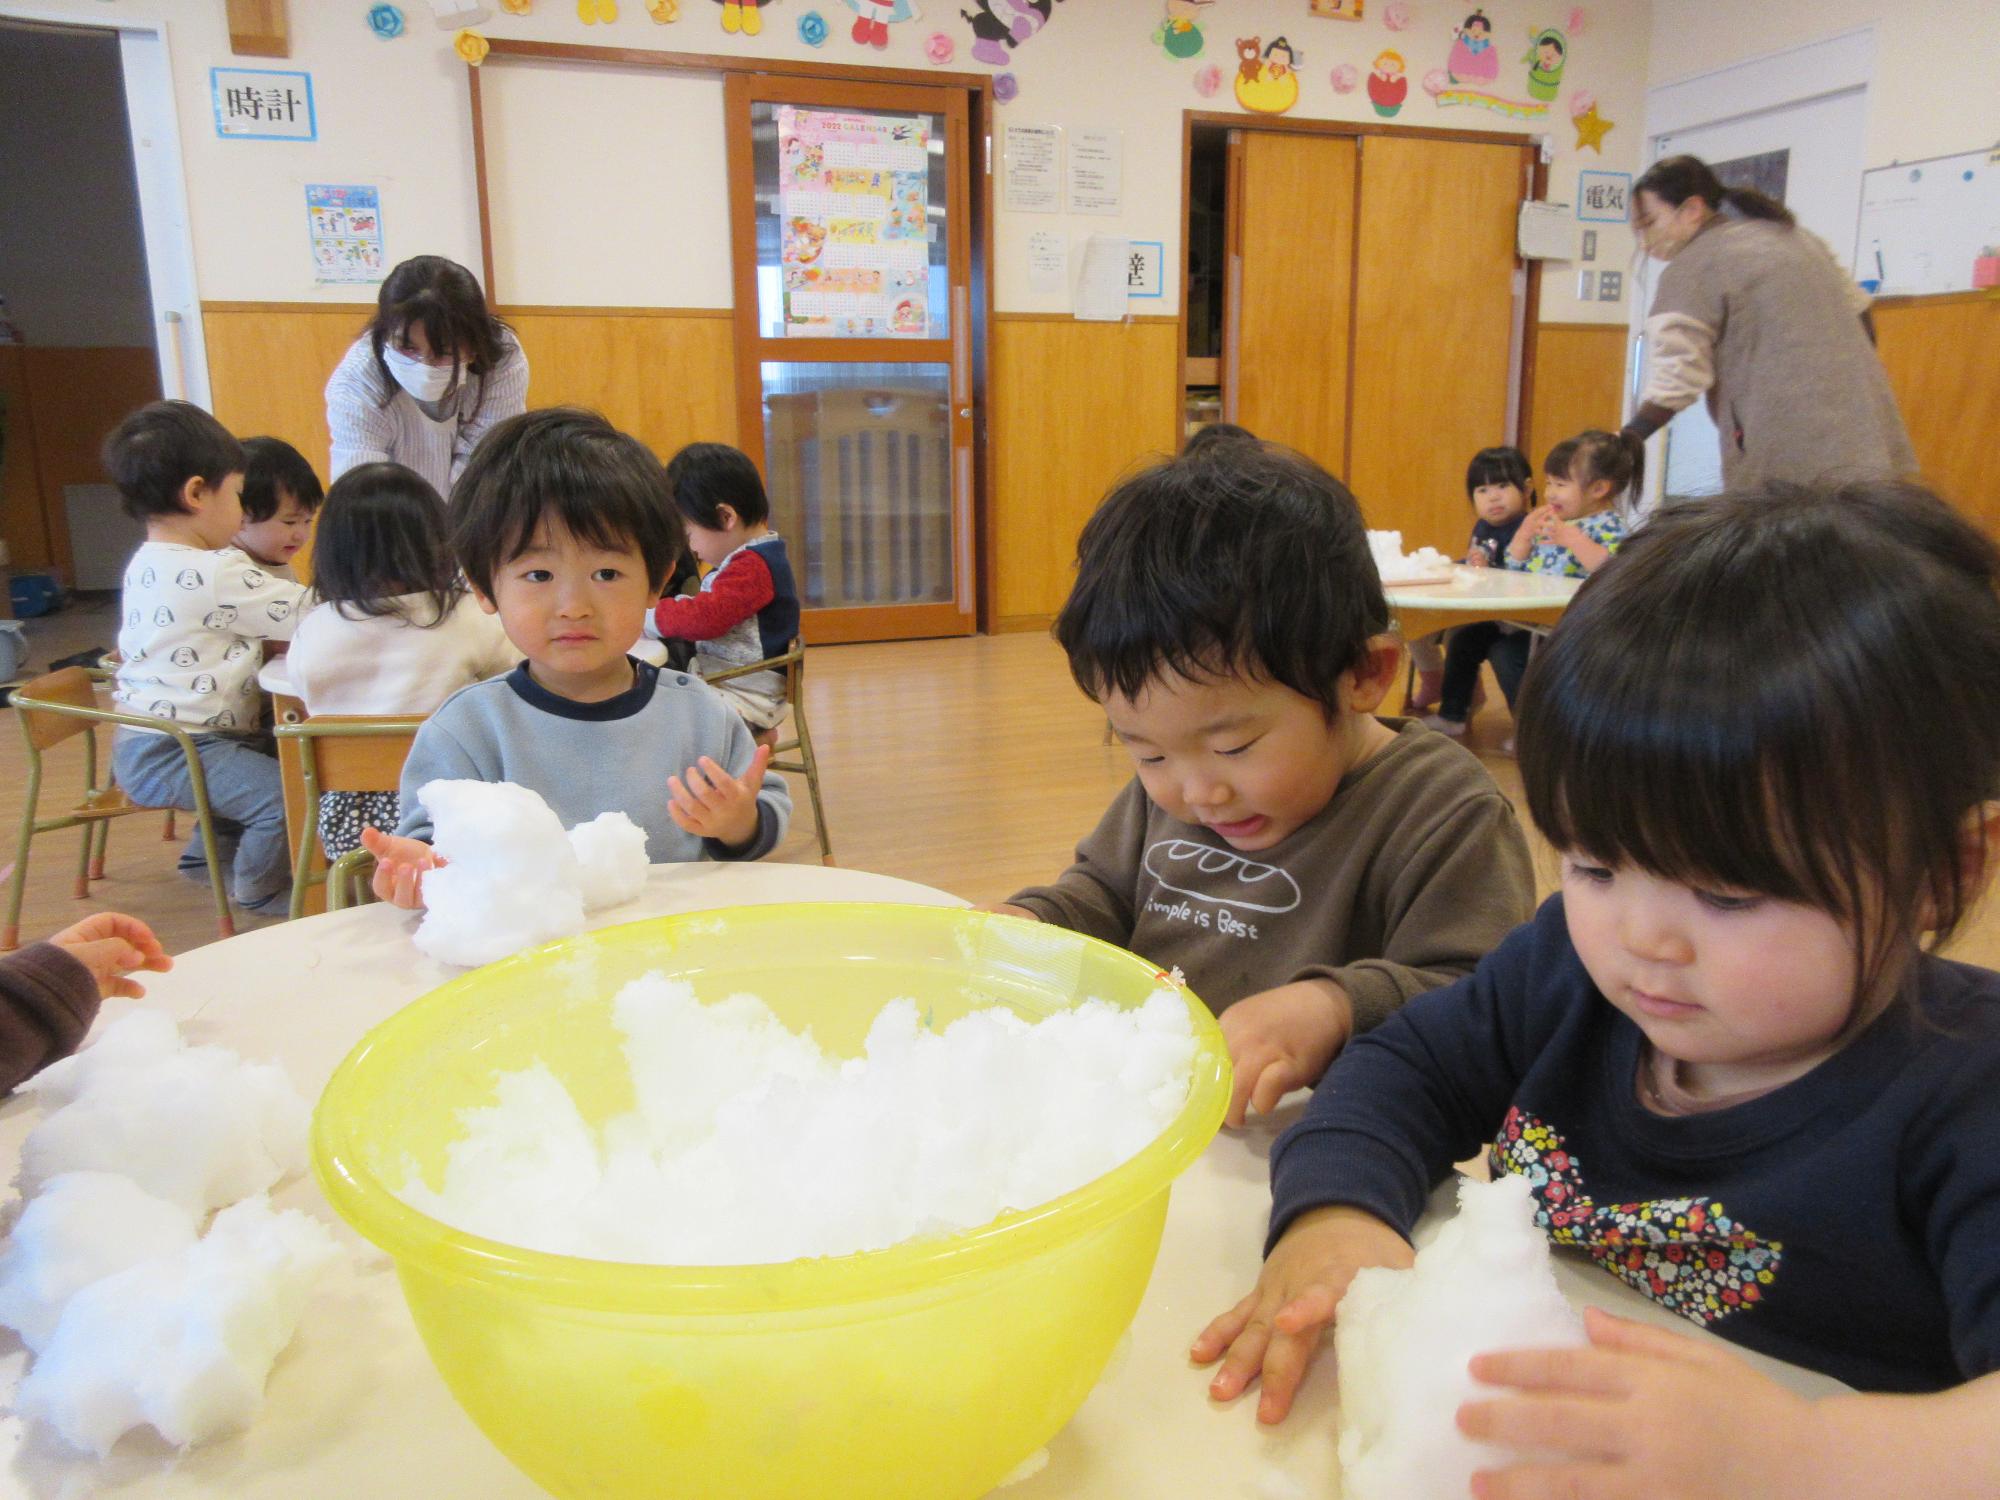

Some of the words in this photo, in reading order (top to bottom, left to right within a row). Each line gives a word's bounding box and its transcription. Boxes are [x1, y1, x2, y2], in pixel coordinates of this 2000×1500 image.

[226, 86, 302, 122] 時計
[822, 121, 842, 130] 2022
[1586, 184, 1625, 210] 電気
[1146, 898, 1190, 921] imple
[1194, 910, 1210, 928] is
[1217, 909, 1259, 940] Best
